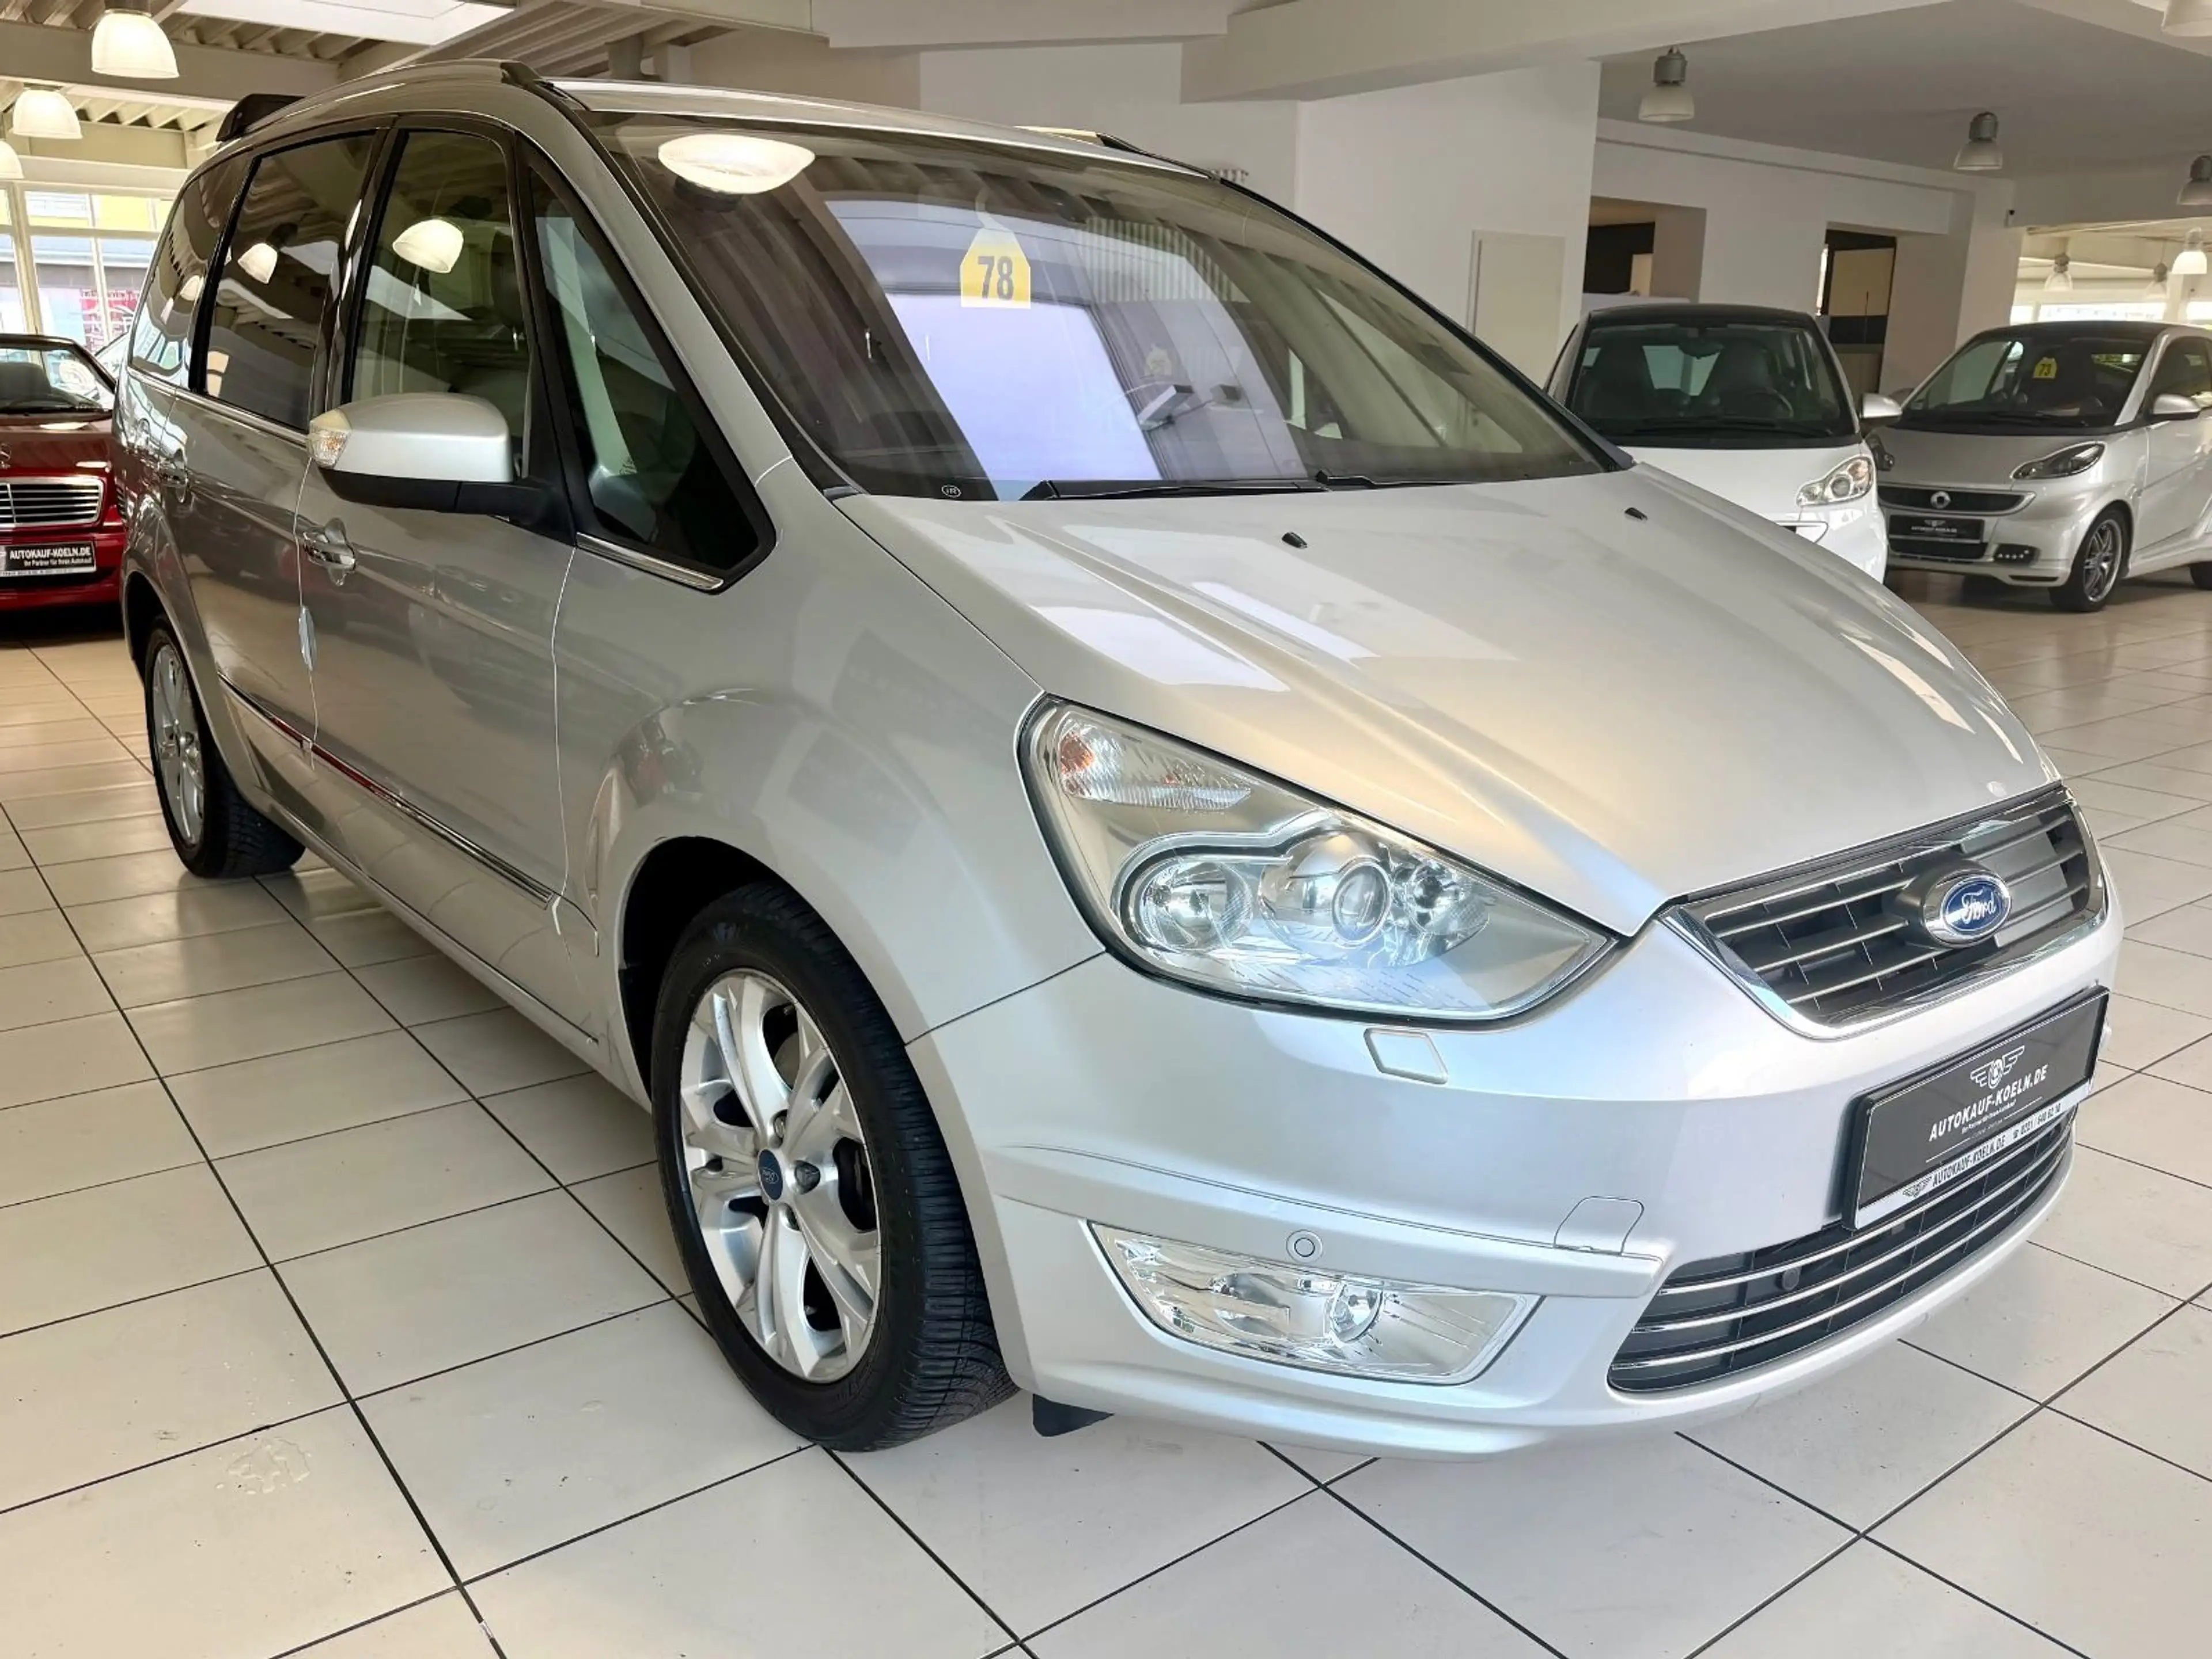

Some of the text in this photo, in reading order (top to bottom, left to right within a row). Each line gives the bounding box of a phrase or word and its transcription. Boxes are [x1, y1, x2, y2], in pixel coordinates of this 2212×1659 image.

[978, 255, 1014, 301] 78
[10, 546, 91, 560] AUTOKAUF-KOELN.DE
[1961, 886, 1997, 925] Ford
[1929, 1063, 2048, 1142] AUTOKAUF-KOELN.DE
